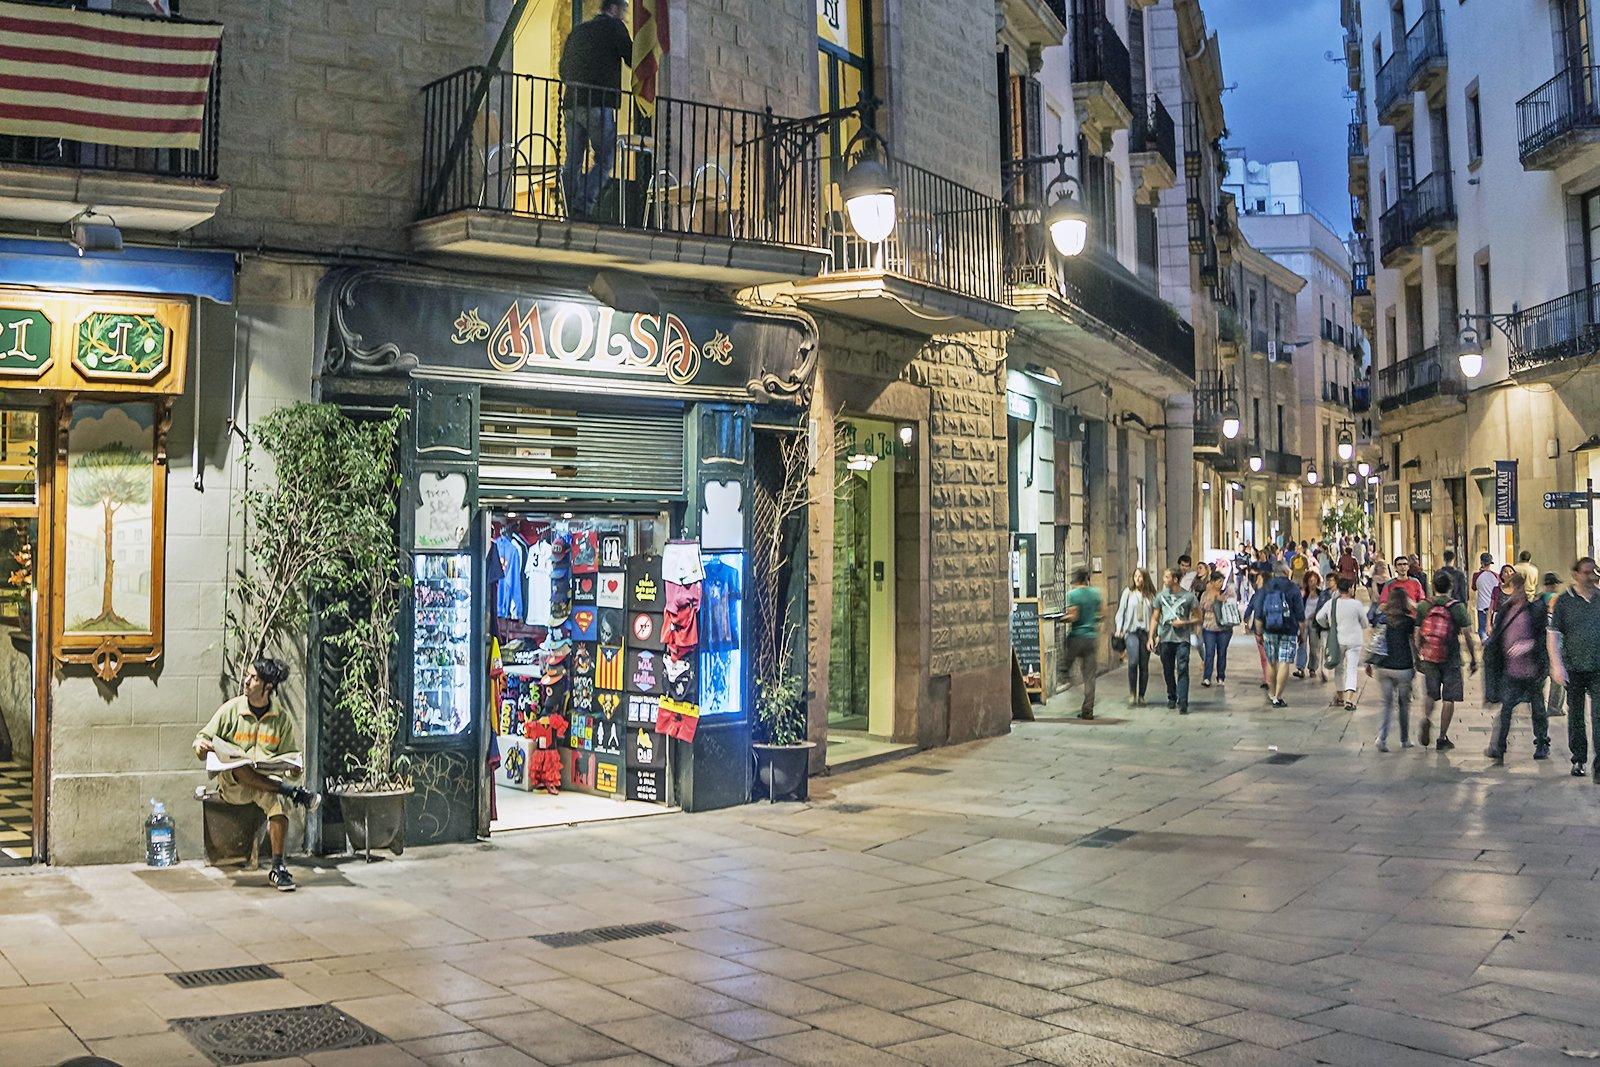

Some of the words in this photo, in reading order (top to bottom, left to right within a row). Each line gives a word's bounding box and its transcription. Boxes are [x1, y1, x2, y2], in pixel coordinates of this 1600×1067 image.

[101, 322, 134, 363] 1
[487, 300, 701, 385] MOLSA
[532, 553, 539, 567] 3
